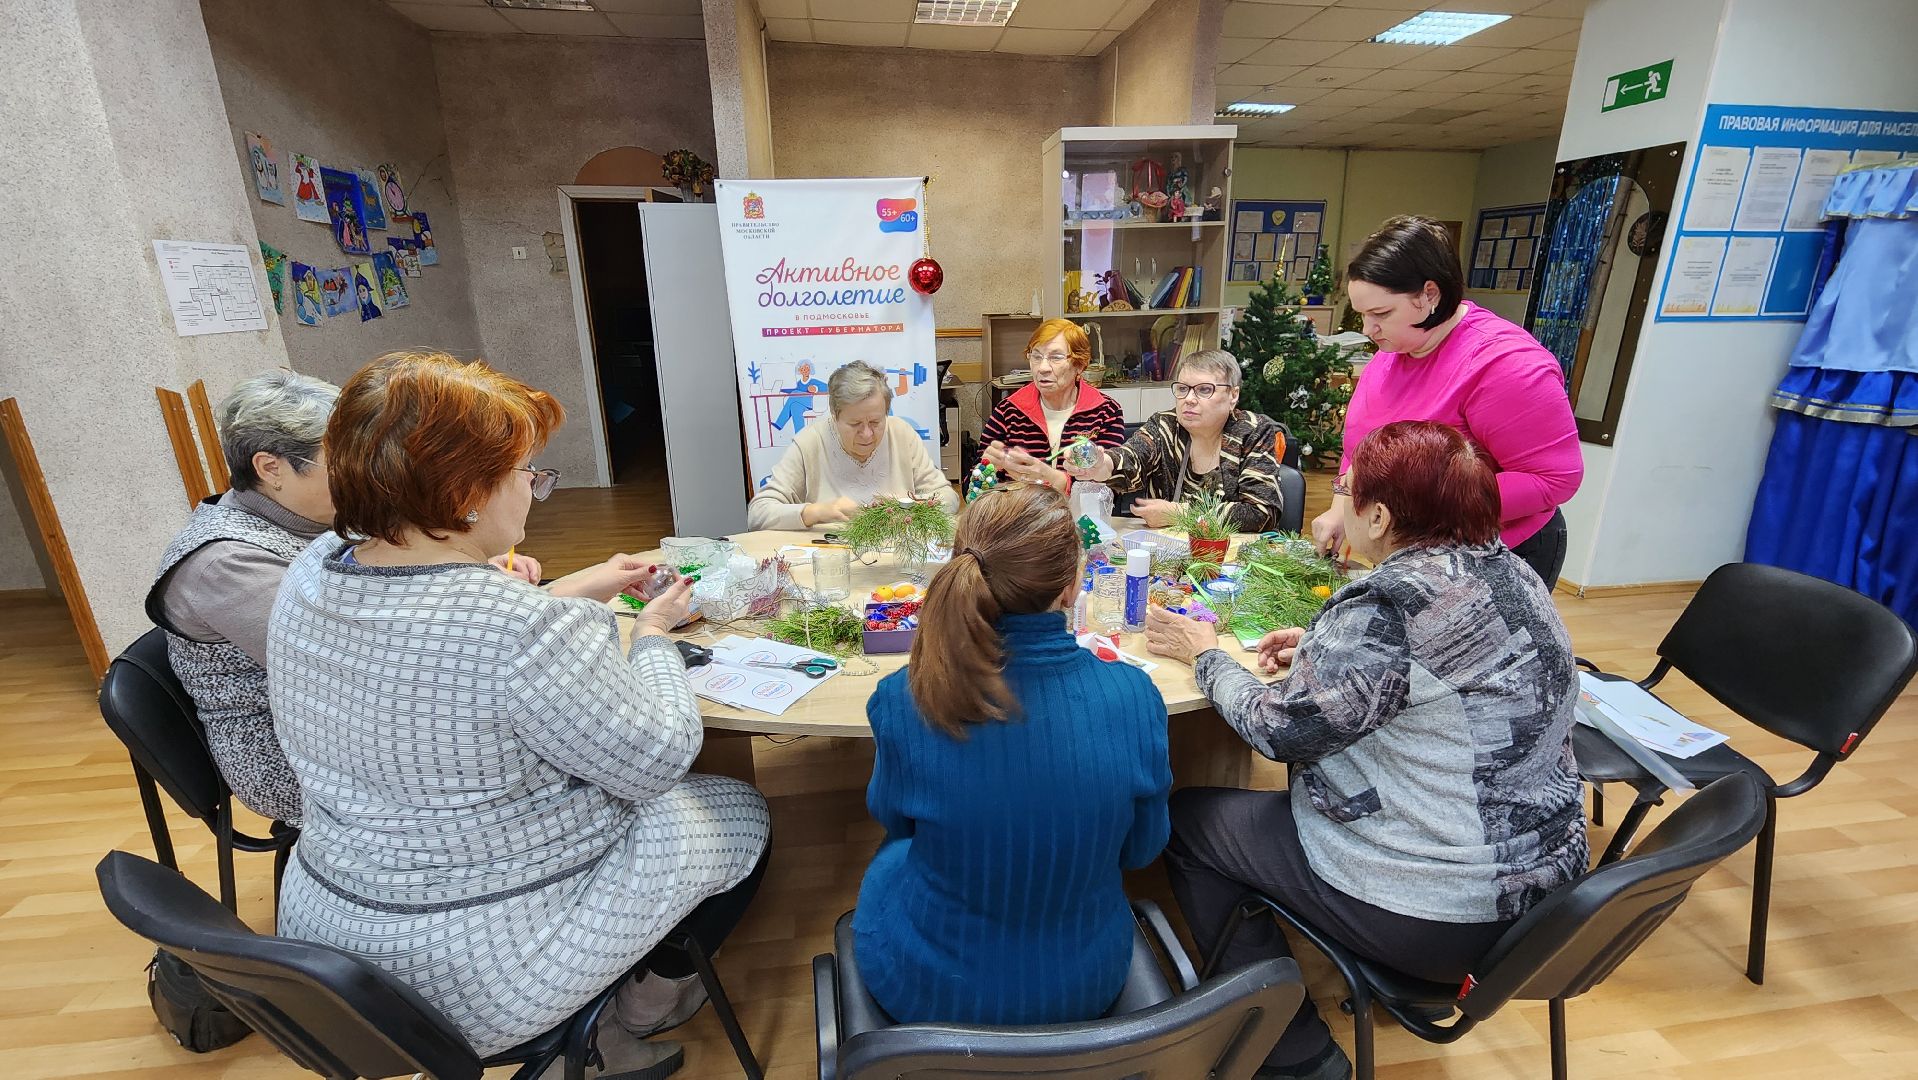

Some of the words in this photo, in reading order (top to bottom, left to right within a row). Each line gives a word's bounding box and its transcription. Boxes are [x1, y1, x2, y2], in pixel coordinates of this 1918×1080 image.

[1719, 115, 1780, 131] ПРАВОВАЯ
[1780, 117, 1859, 136] ИНФОРМАЦИЯ
[1857, 120, 1883, 137] ДЛЯ
[881, 207, 898, 218] 55+
[900, 213, 916, 223] 60+
[755, 257, 901, 285] Активное
[758, 281, 906, 308] долголетие
[803, 312, 870, 321] ПОДМОСКОВЬЕ
[766, 327, 811, 336] ПРОЕКТ
[820, 324, 902, 334] ГУБЕРНАТОРА
